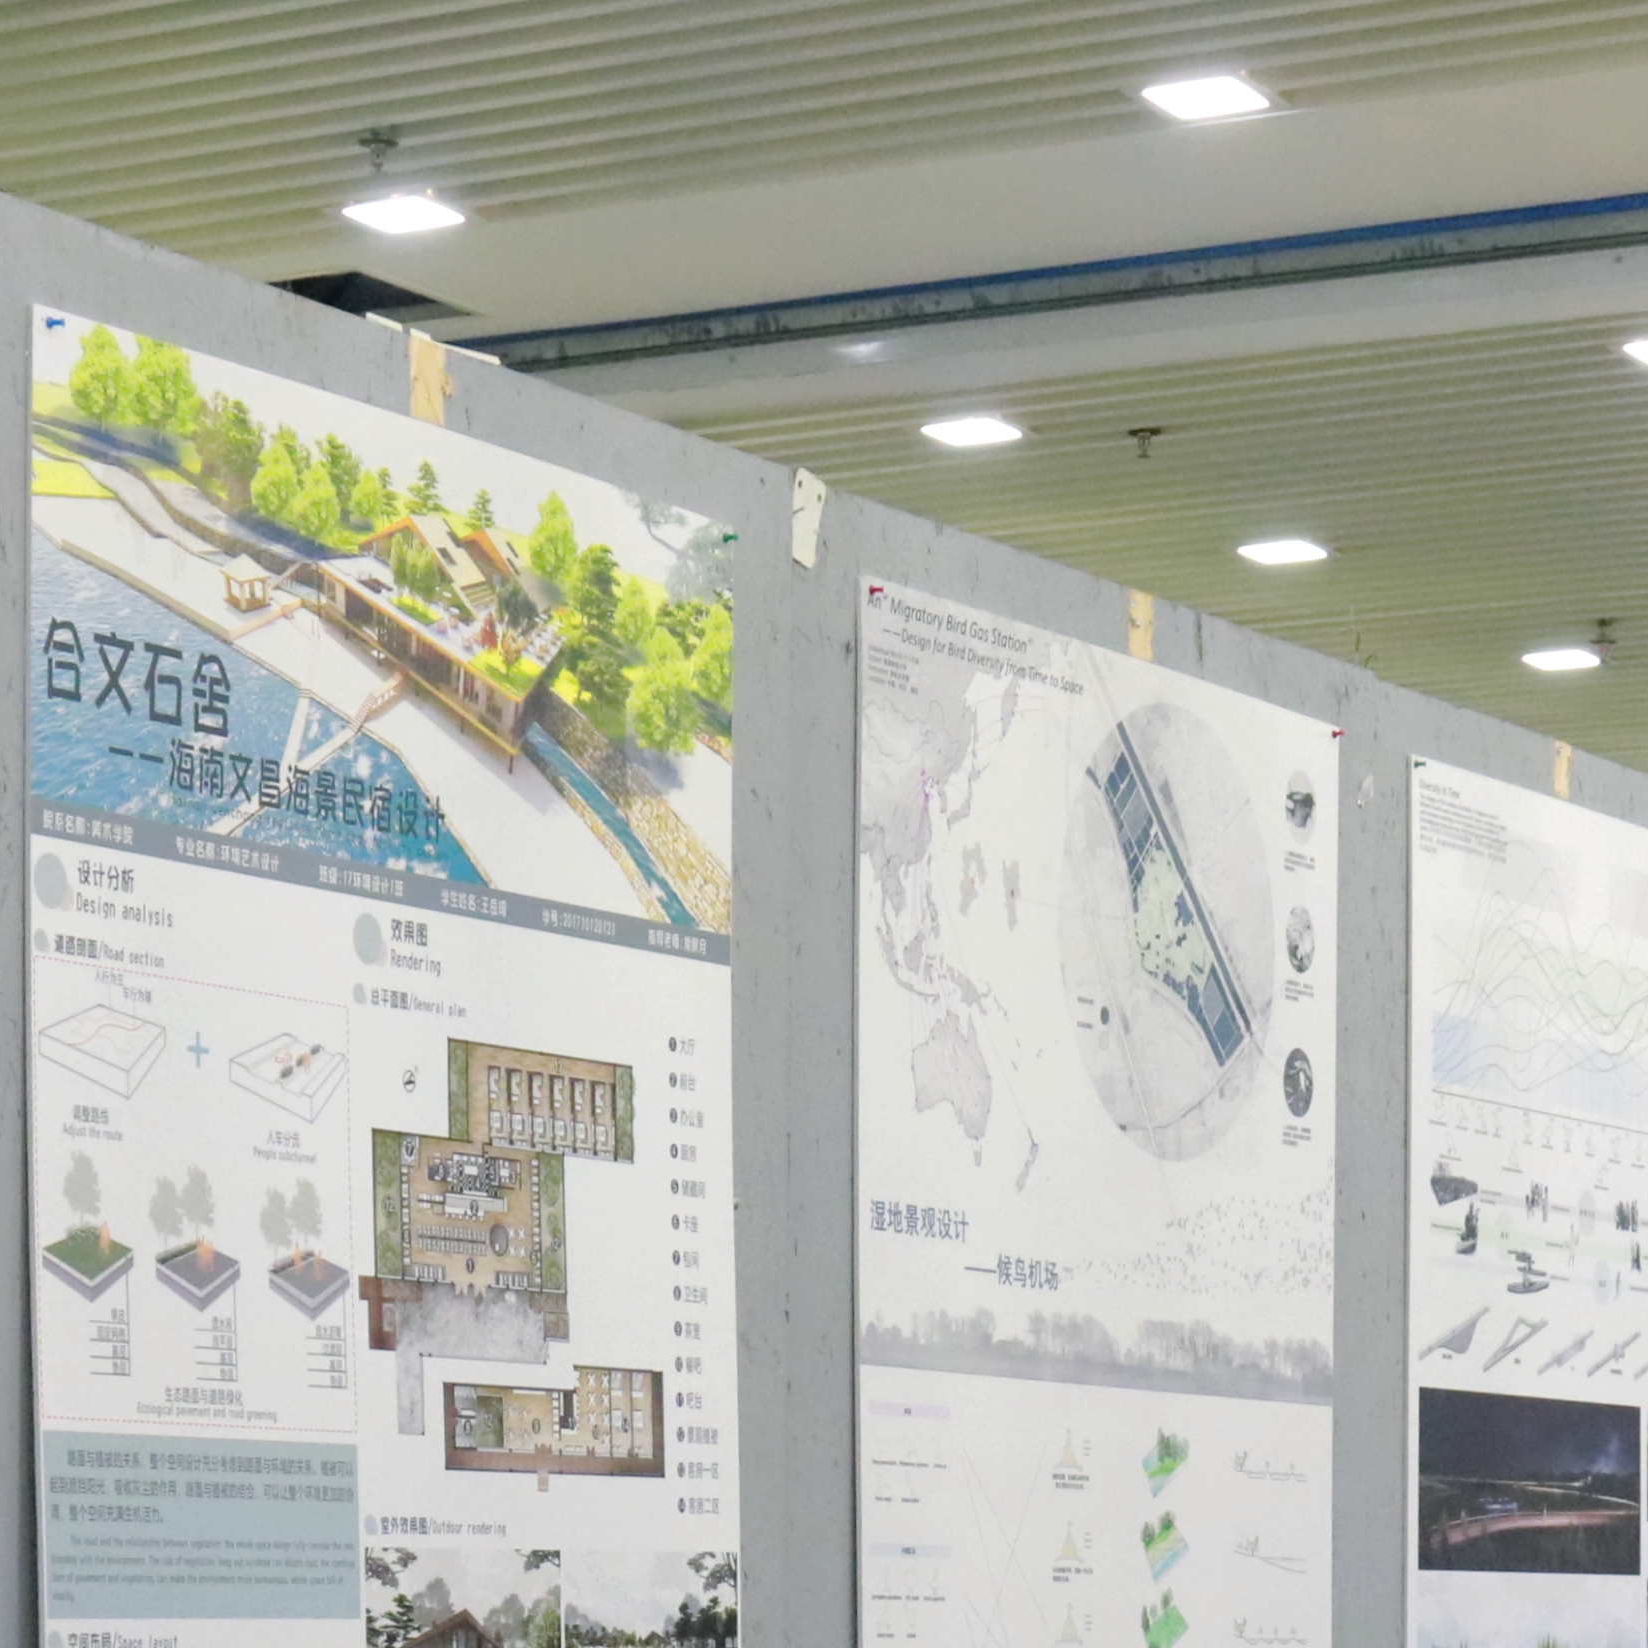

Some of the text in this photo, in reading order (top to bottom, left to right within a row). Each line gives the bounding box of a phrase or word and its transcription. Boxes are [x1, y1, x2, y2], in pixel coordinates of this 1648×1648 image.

[890, 597, 944, 632] Migratory
[946, 614, 968, 635] Bird
[969, 624, 989, 643] Gas
[933, 638, 946, 655] for
[947, 641, 966, 661] Bird
[967, 648, 1005, 671] Diversity
[1003, 658, 1027, 679] from
[1028, 664, 1050, 684] Time
[77, 859, 135, 893] 设计分析
[76, 892, 173, 928] Design analysis
[390, 917, 428, 948] 效果图
[129, 949, 165, 968] section
[390, 949, 441, 978] Rendering
[448, 1003, 467, 1018] plan
[89, 1127, 102, 1140] the
[103, 1127, 123, 1142] route
[253, 1145, 277, 1161] People
[870, 1200, 969, 1243] 湿地景观设计
